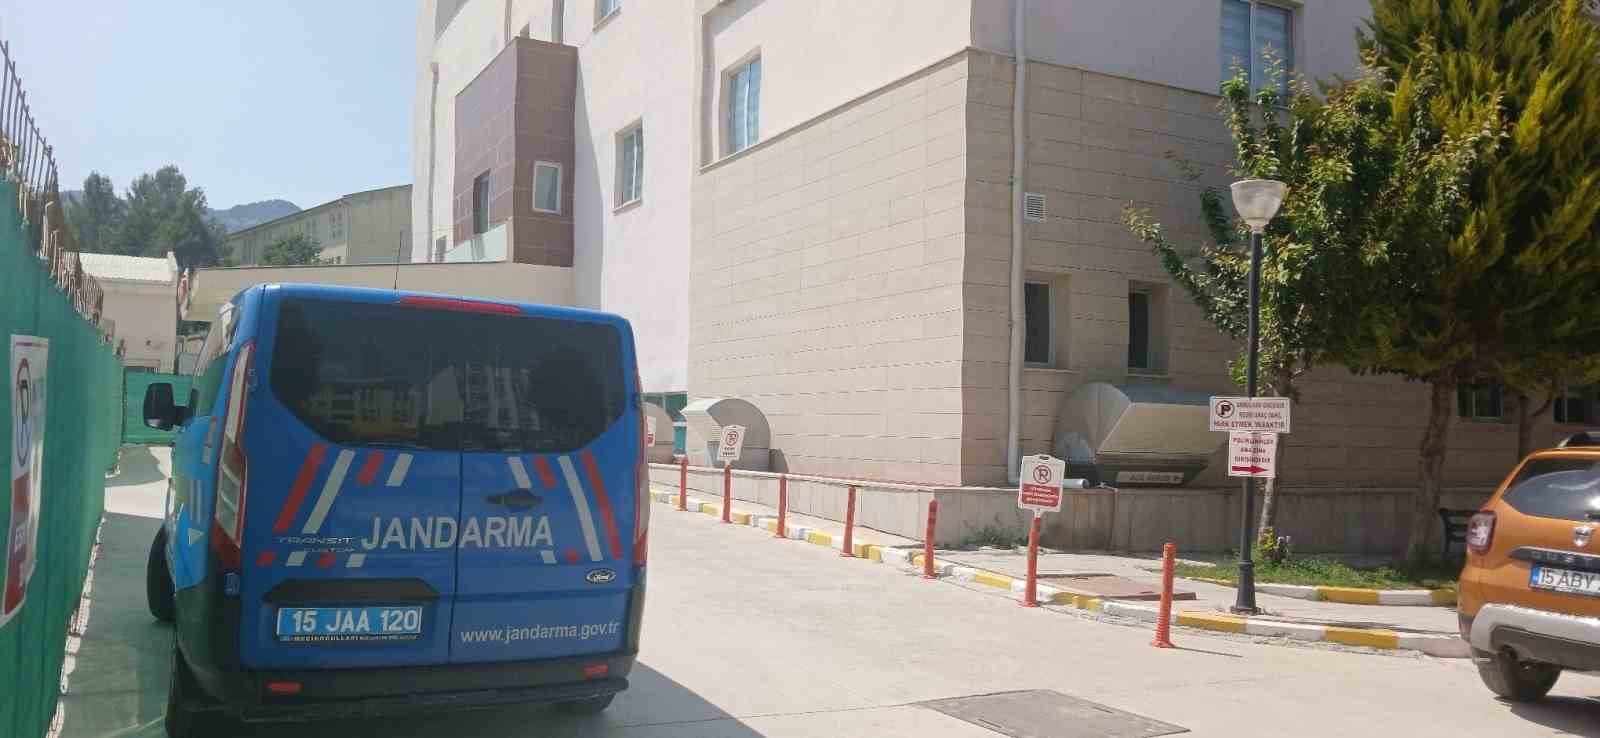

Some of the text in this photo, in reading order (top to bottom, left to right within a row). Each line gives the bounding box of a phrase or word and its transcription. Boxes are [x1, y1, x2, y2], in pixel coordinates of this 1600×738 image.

[361, 516, 554, 550] JANDARMA
[292, 609, 419, 633] 15 JAA 120
[460, 620, 621, 643] www.jandarma.gov.tr
